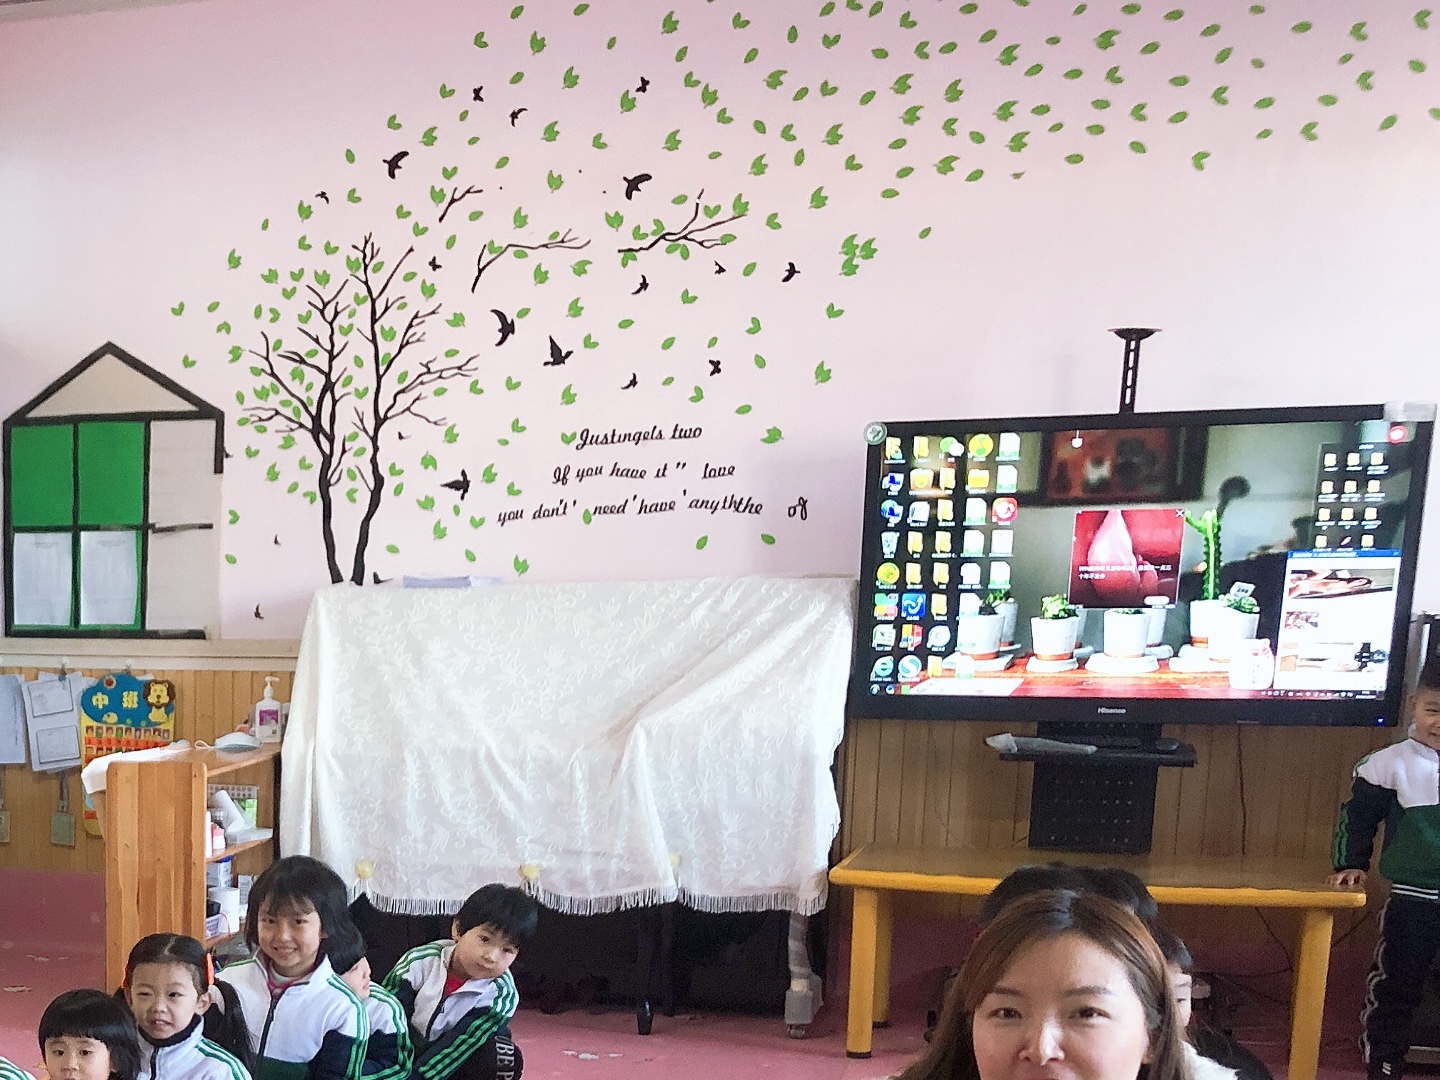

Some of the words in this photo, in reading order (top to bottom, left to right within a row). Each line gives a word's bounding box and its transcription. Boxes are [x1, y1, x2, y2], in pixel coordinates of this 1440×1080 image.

[670, 423, 702, 440] two
[553, 464, 570, 486] If
[576, 465, 603, 483] you
[610, 461, 647, 479] have
[702, 462, 736, 480] love
[497, 508, 524, 527] you
[787, 496, 809, 521] of
